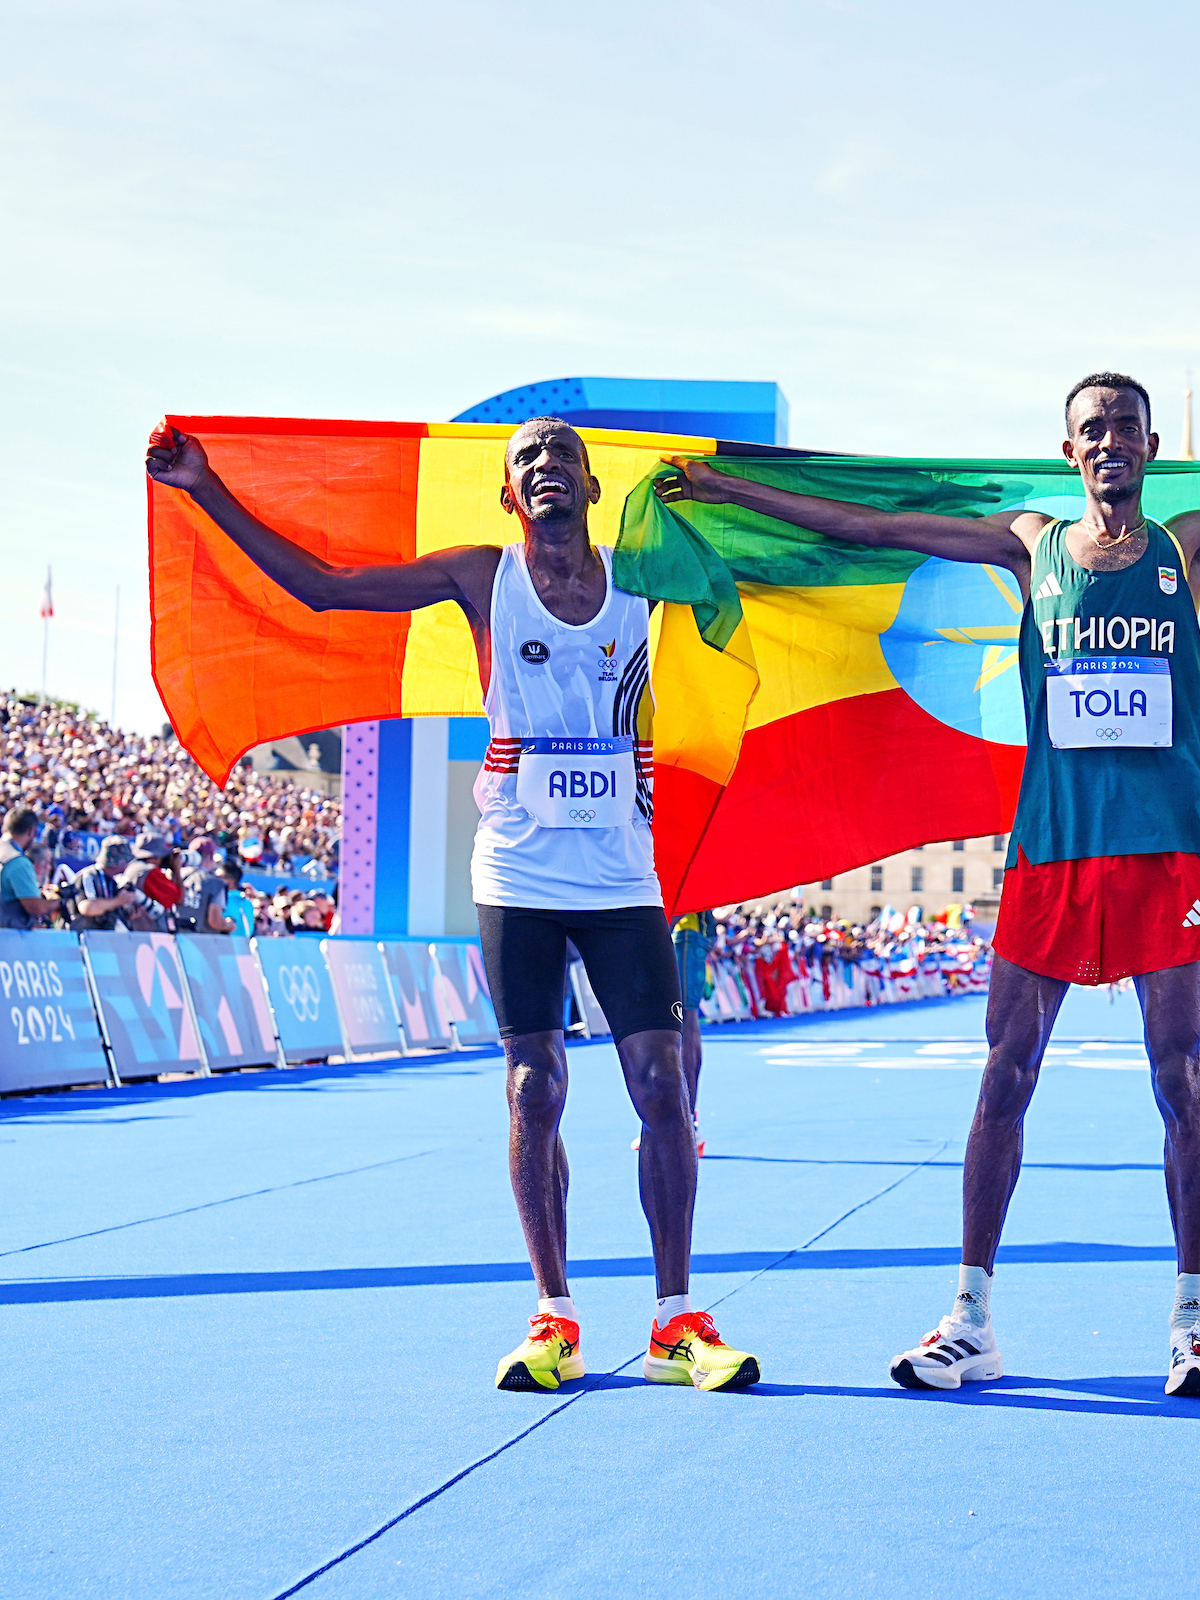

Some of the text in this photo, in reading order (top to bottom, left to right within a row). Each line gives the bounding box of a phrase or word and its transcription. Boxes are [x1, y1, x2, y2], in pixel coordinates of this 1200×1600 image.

[1042, 616, 1175, 654] ETHIOPIA
[1111, 661, 1140, 670] 2024
[1069, 689, 1147, 718] TOLA
[587, 742, 613, 751] 2024
[548, 770, 617, 798] ABDI
[11, 1005, 75, 1045] 2024
